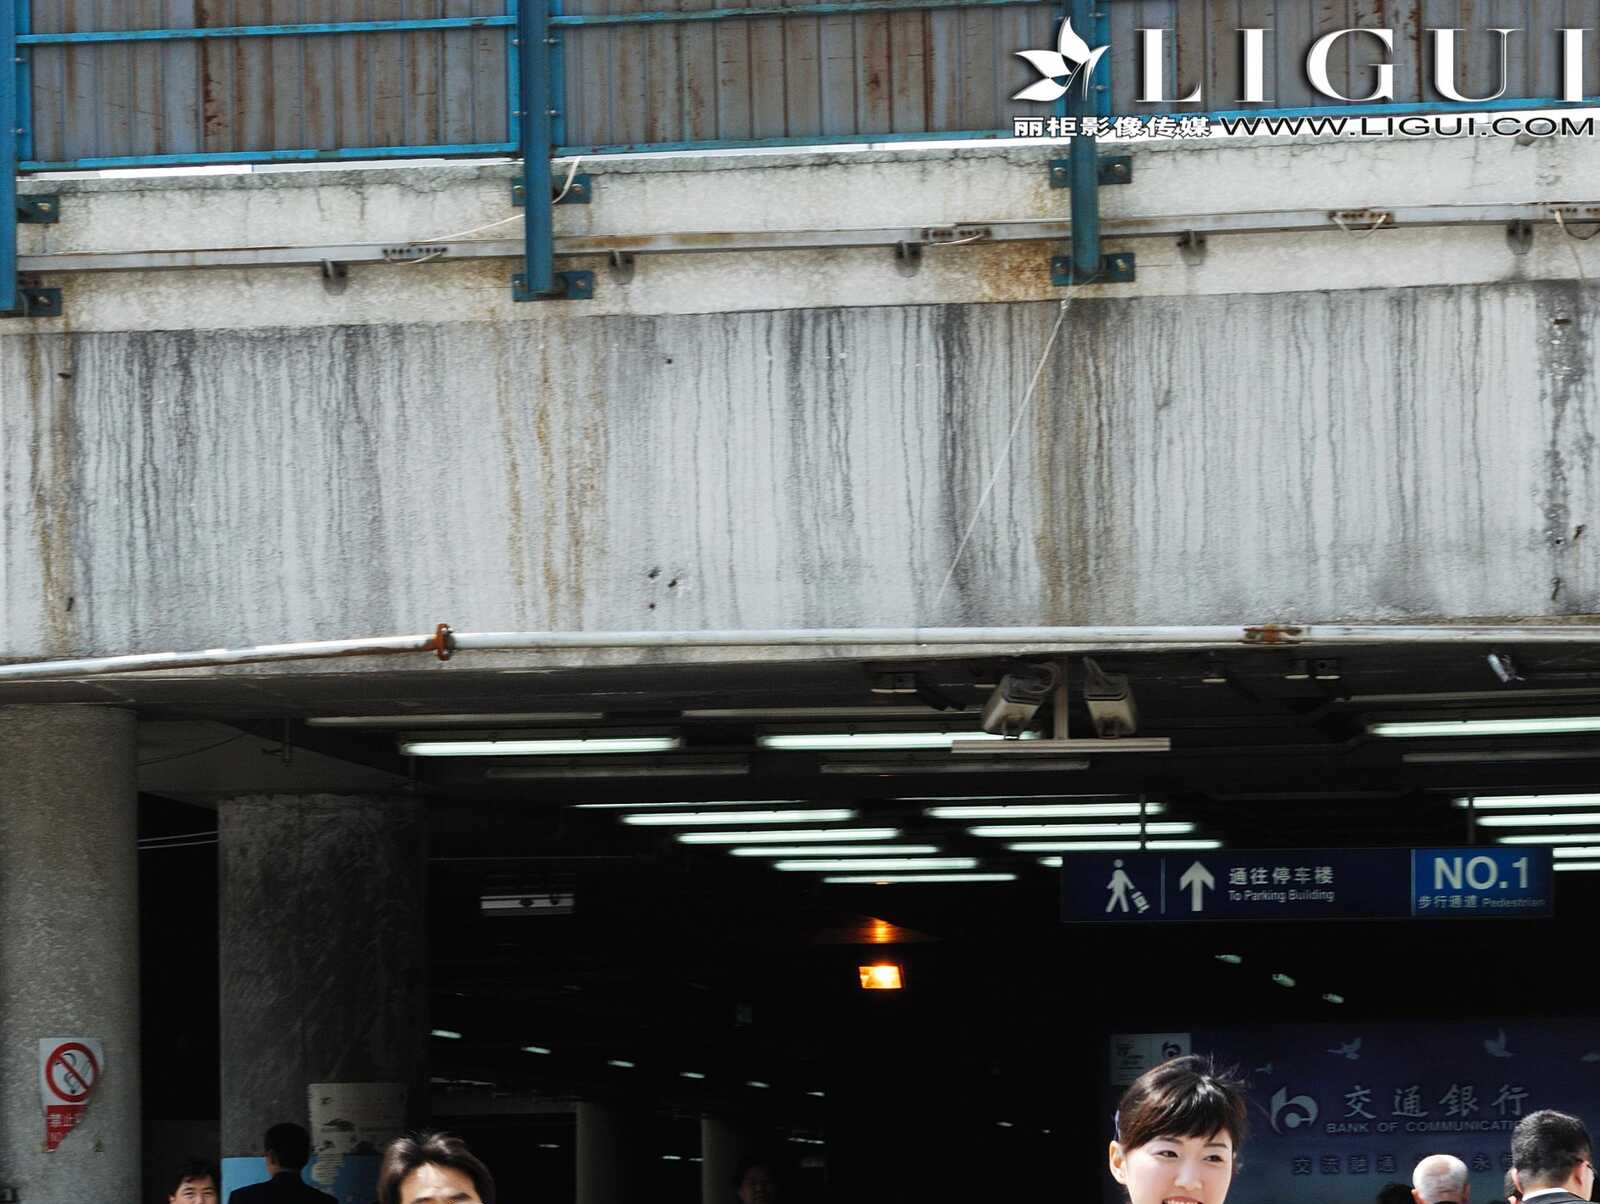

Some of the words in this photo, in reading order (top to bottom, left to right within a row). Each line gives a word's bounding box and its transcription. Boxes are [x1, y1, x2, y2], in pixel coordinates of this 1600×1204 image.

[1229, 866, 1335, 885] 通往停车楼
[1434, 855, 1529, 890] NO.1
[1228, 890, 1243, 901] To
[1244, 889, 1287, 903] Parking
[1288, 889, 1335, 903] Building
[1417, 895, 1478, 909] 步行通道
[1343, 1084, 1530, 1120] 交通銀行
[1326, 1121, 1369, 1134] BANK
[1376, 1121, 1398, 1133] OF
[1406, 1119, 1517, 1132] COMMUNICATI
